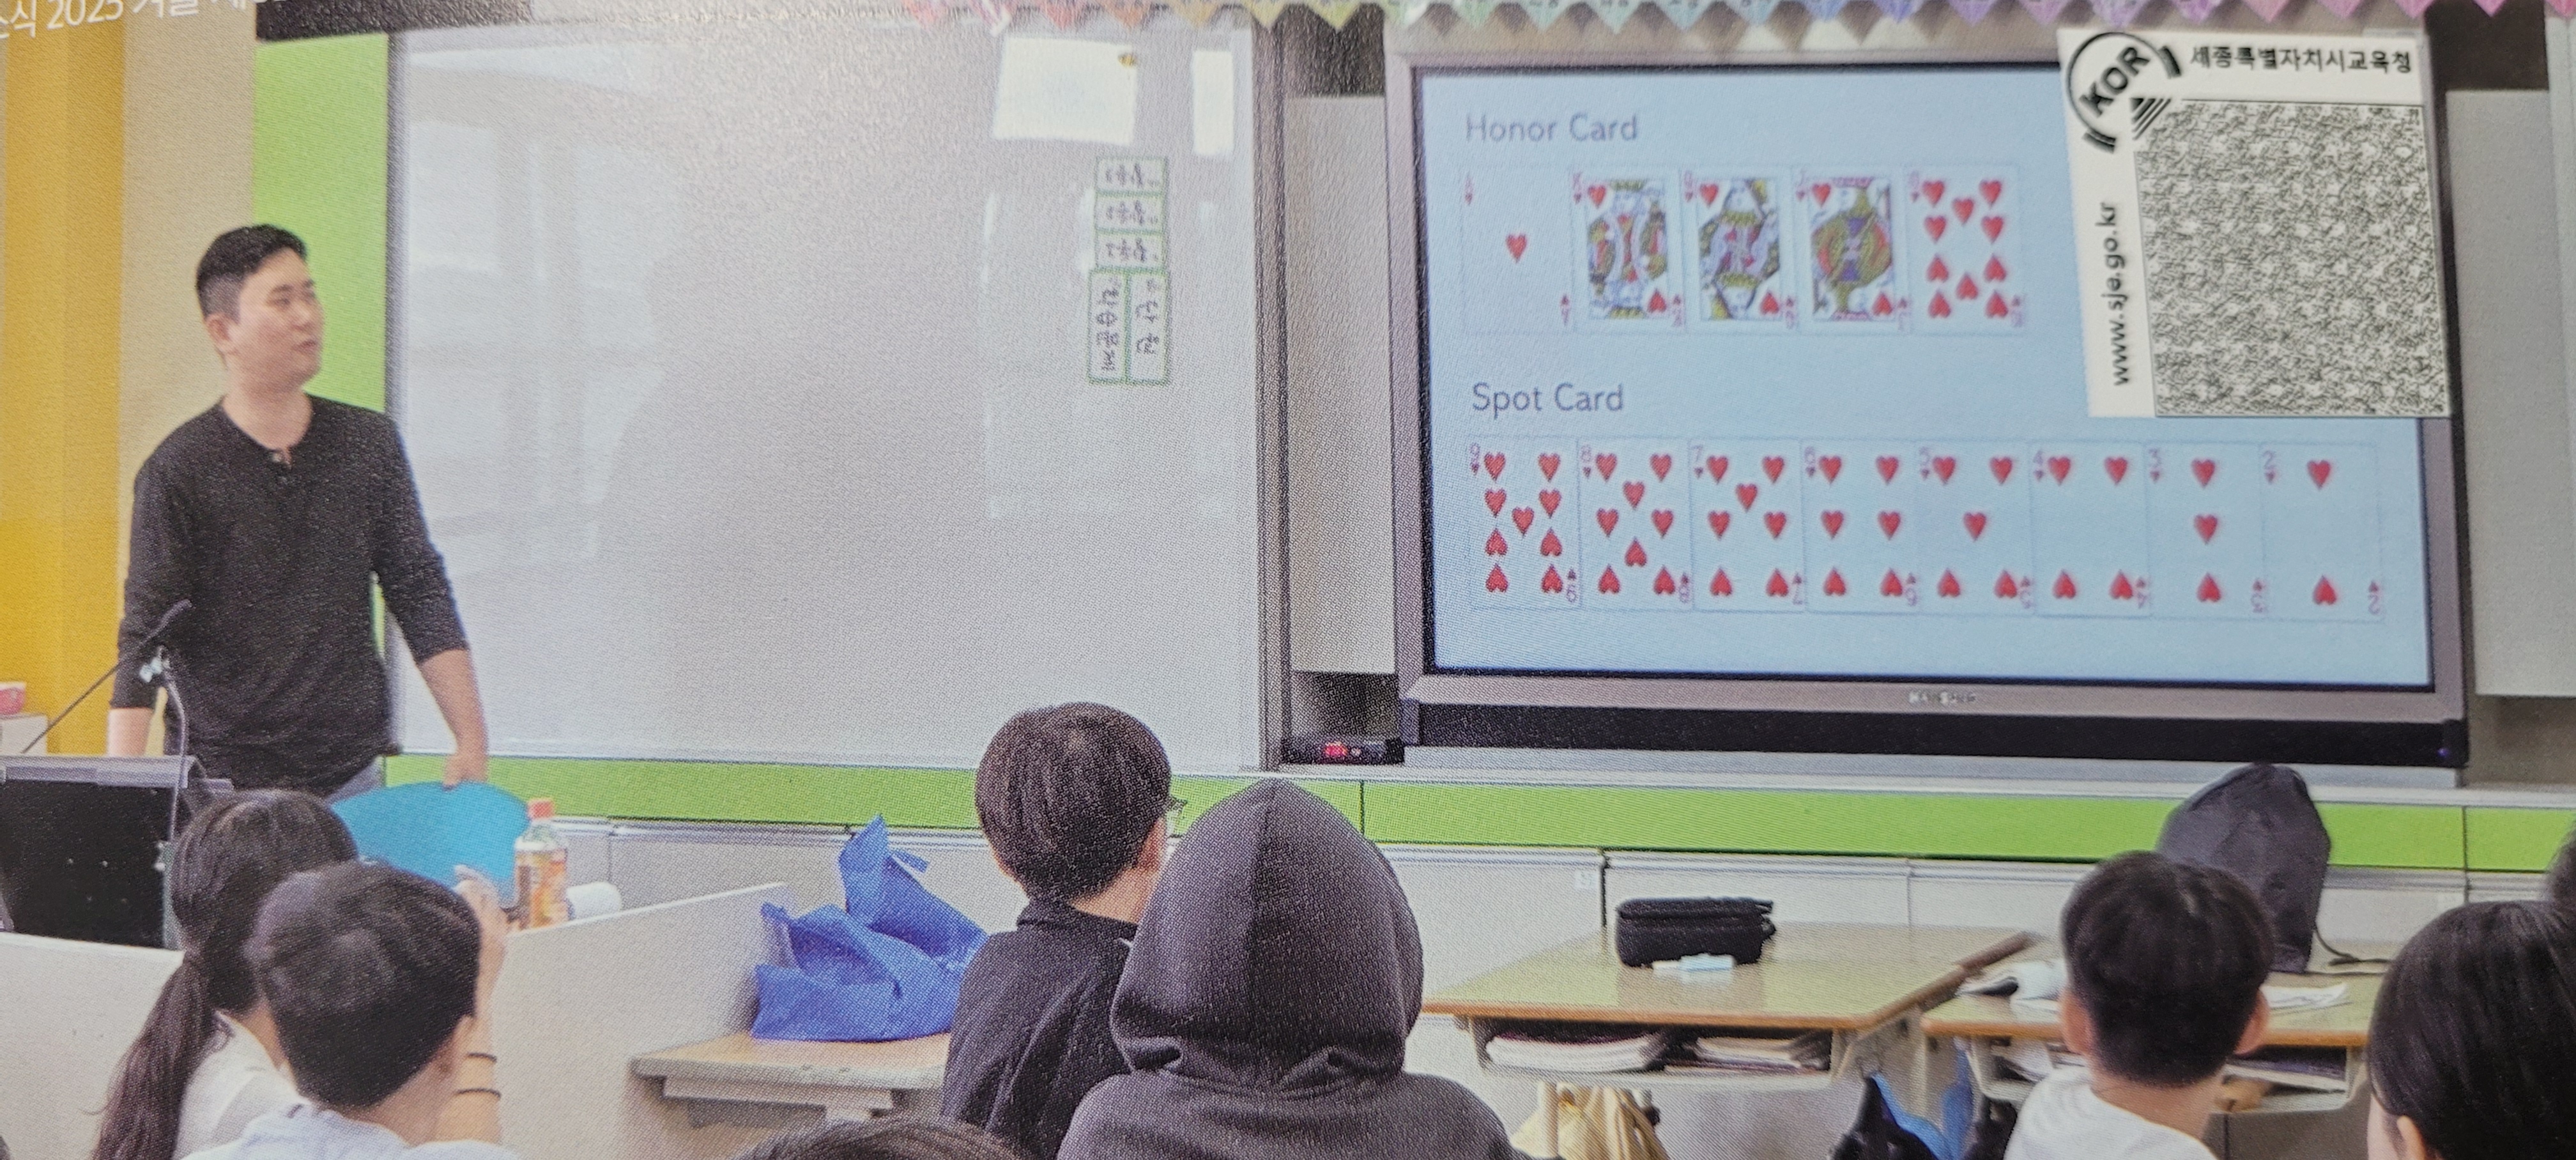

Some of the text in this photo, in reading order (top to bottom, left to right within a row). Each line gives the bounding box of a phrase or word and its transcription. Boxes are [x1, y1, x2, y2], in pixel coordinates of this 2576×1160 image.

[1465, 111, 1637, 142] Honor Card
[1471, 381, 1625, 420] Spot Card
[1470, 443, 1480, 463] 9
[1690, 445, 1704, 462] 7
[2032, 449, 2044, 466] 4
[2149, 448, 2161, 468] 3
[2263, 450, 2276, 470] 2
